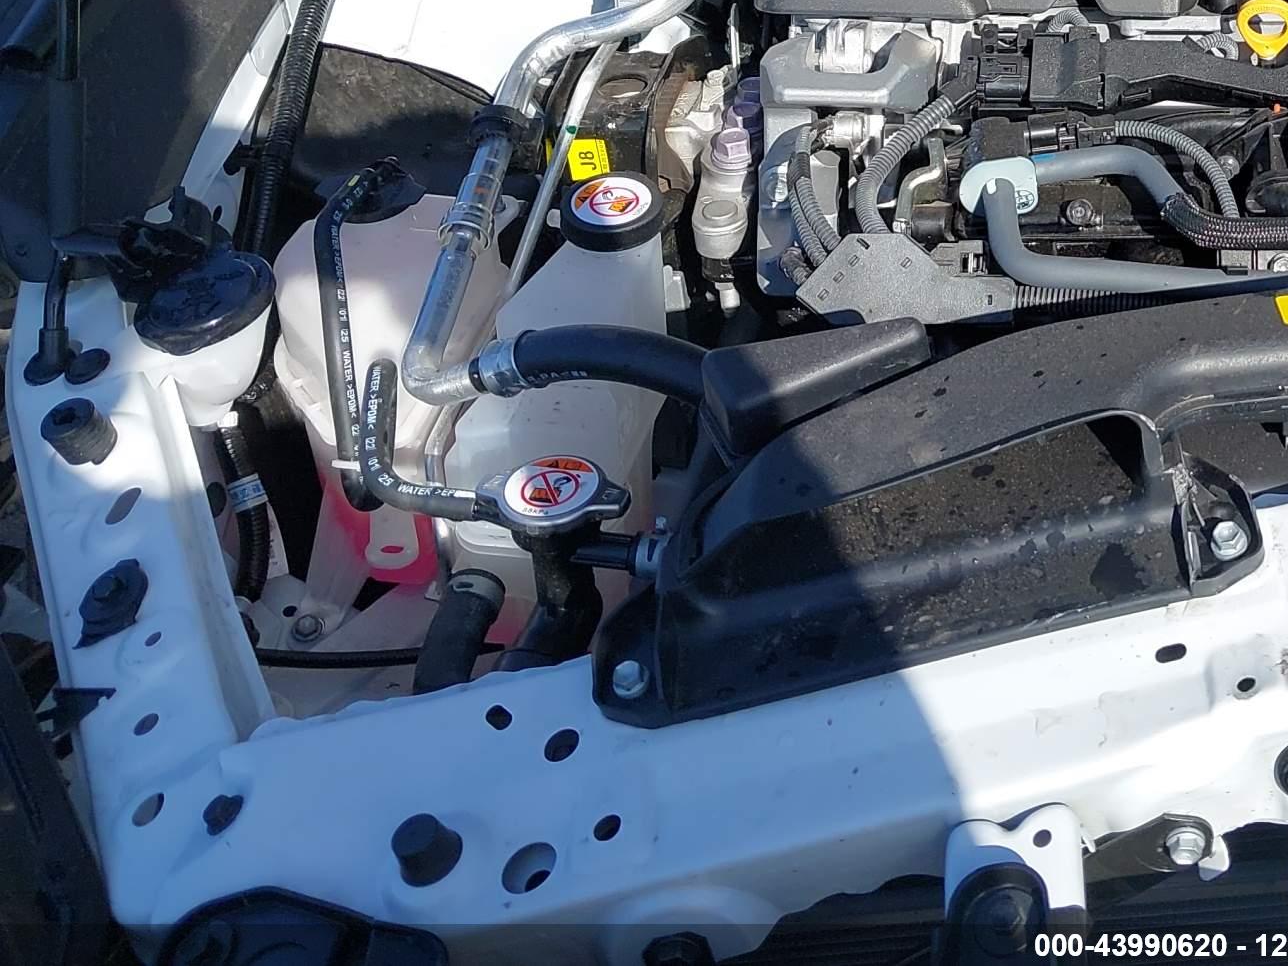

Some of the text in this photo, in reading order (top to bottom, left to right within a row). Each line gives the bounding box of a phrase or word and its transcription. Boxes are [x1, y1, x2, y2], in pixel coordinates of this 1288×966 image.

[578, 151, 597, 170] J8
[342, 350, 353, 382] WATER
[397, 483, 432, 496] WATER
